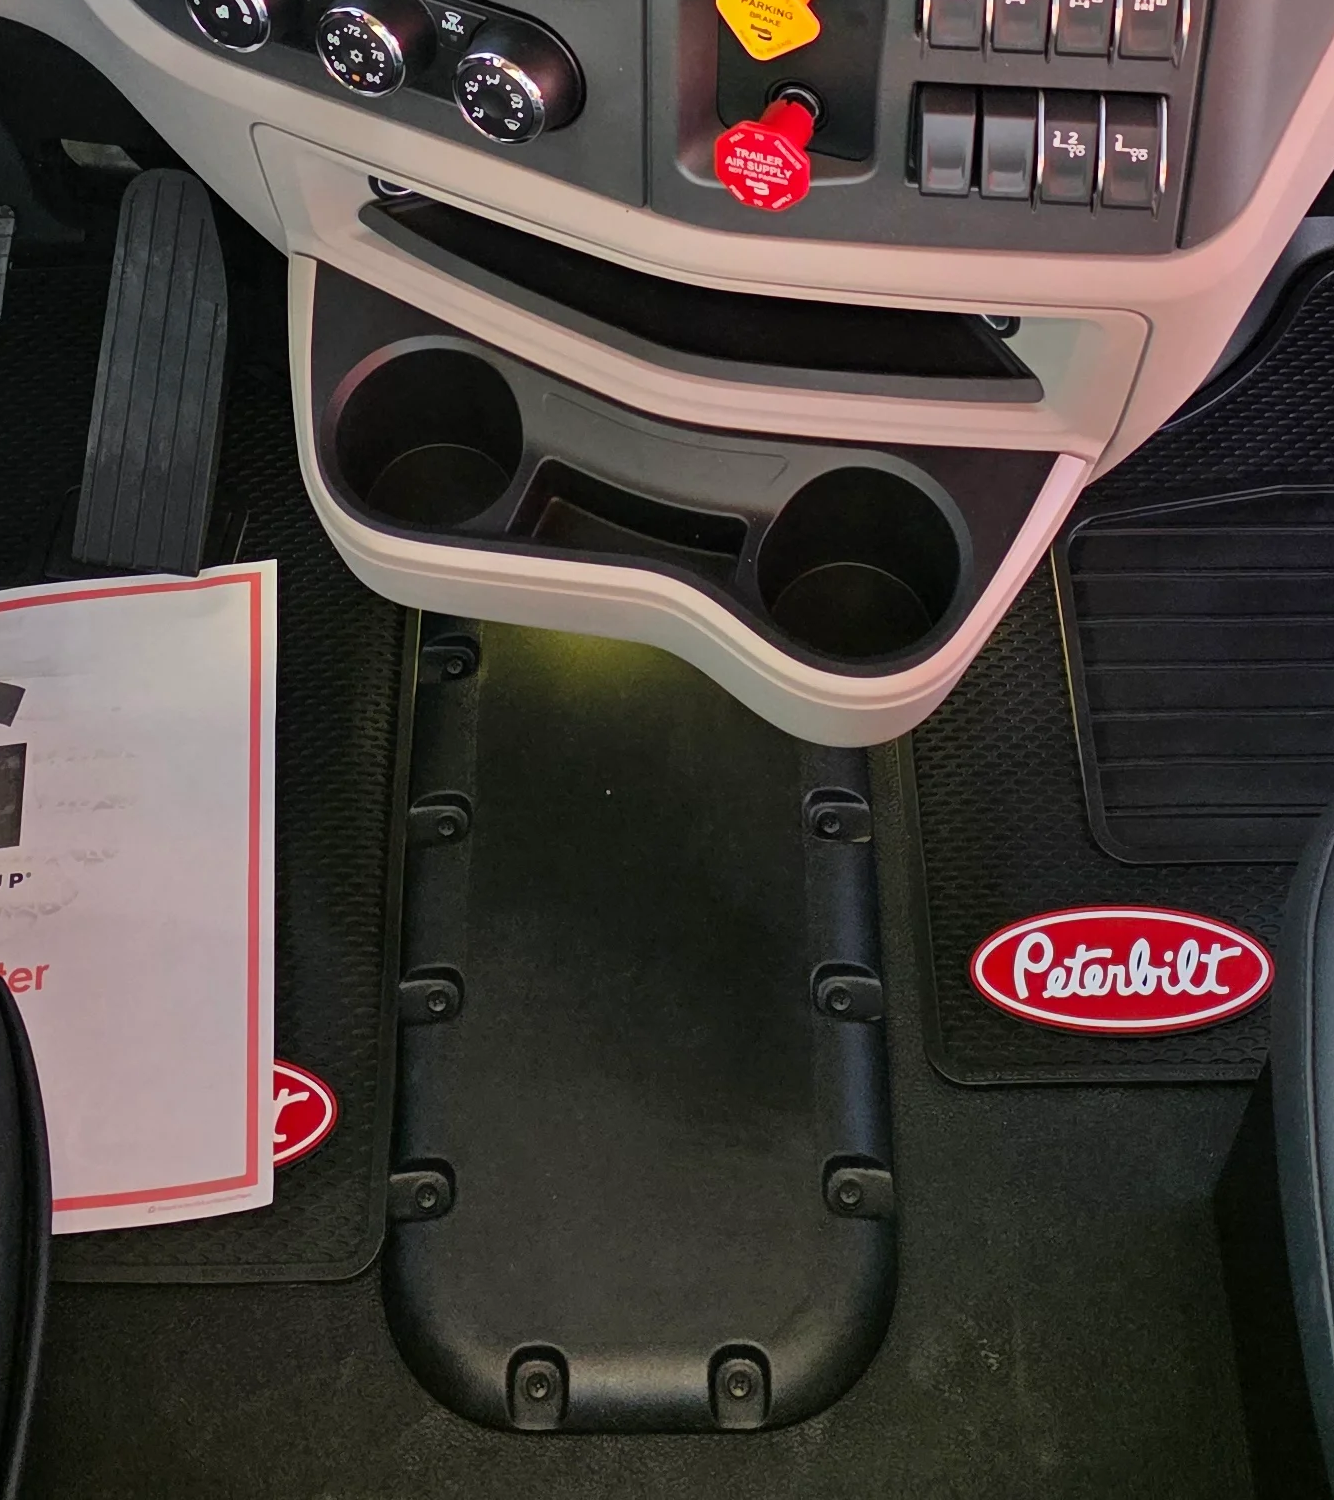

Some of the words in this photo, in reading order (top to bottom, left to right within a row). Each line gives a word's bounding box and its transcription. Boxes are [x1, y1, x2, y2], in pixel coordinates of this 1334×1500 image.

[749, 11, 781, 27] BRAKE
[347, 24, 361, 38] 72
[441, 19, 465, 35] MAX
[370, 49, 385, 62] 78
[333, 61, 347, 73] 60
[754, 133, 765, 141] TO
[734, 147, 784, 167] TRAILER
[725, 156, 745, 169] AIR
[746, 161, 793, 179] SUPPLY
[728, 166, 742, 175] NOT
[743, 169, 758, 179] FOR
[1013, 931, 1243, 1000] Peterbilt
